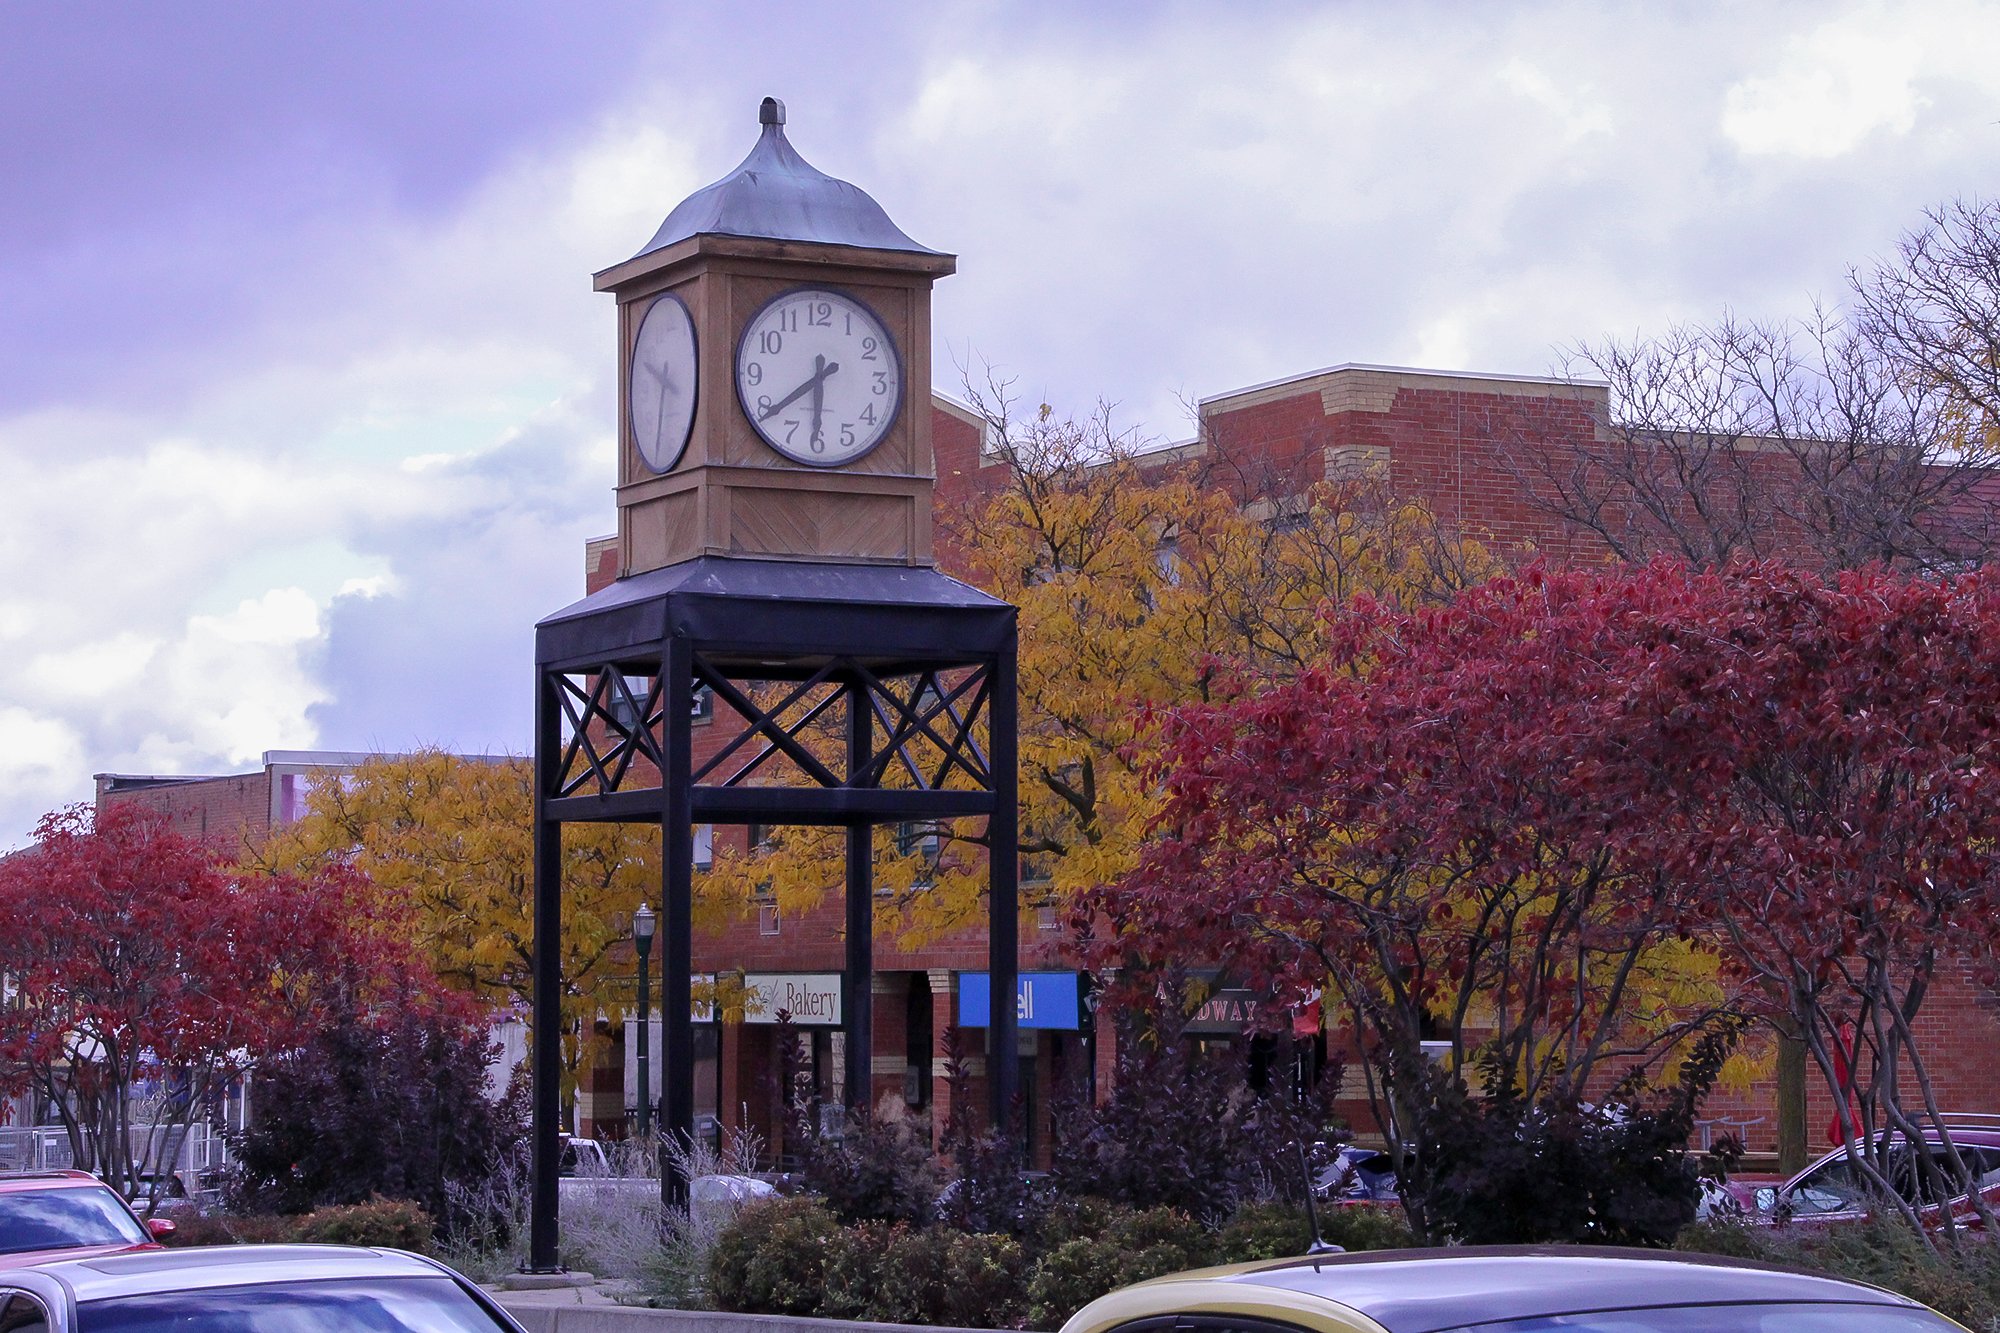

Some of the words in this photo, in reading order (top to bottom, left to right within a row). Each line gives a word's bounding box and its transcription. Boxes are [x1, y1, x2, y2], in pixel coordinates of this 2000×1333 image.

[780, 308, 798, 332] 11
[808, 302, 832, 327] 12
[844, 312, 852, 336] 1
[759, 330, 782, 354] 10
[861, 337, 878, 361] 2
[747, 362, 763, 386] 9
[872, 371, 887, 395] 3
[758, 395, 774, 419] 8
[859, 402, 877, 426] 4
[784, 420, 800, 444] 7
[810, 429, 825, 453] 6
[840, 423, 855, 447] 5
[786, 982, 836, 1022] Bakery
[1017, 980, 1033, 1019] ell
[1194, 1000, 1257, 1022] DWAY
